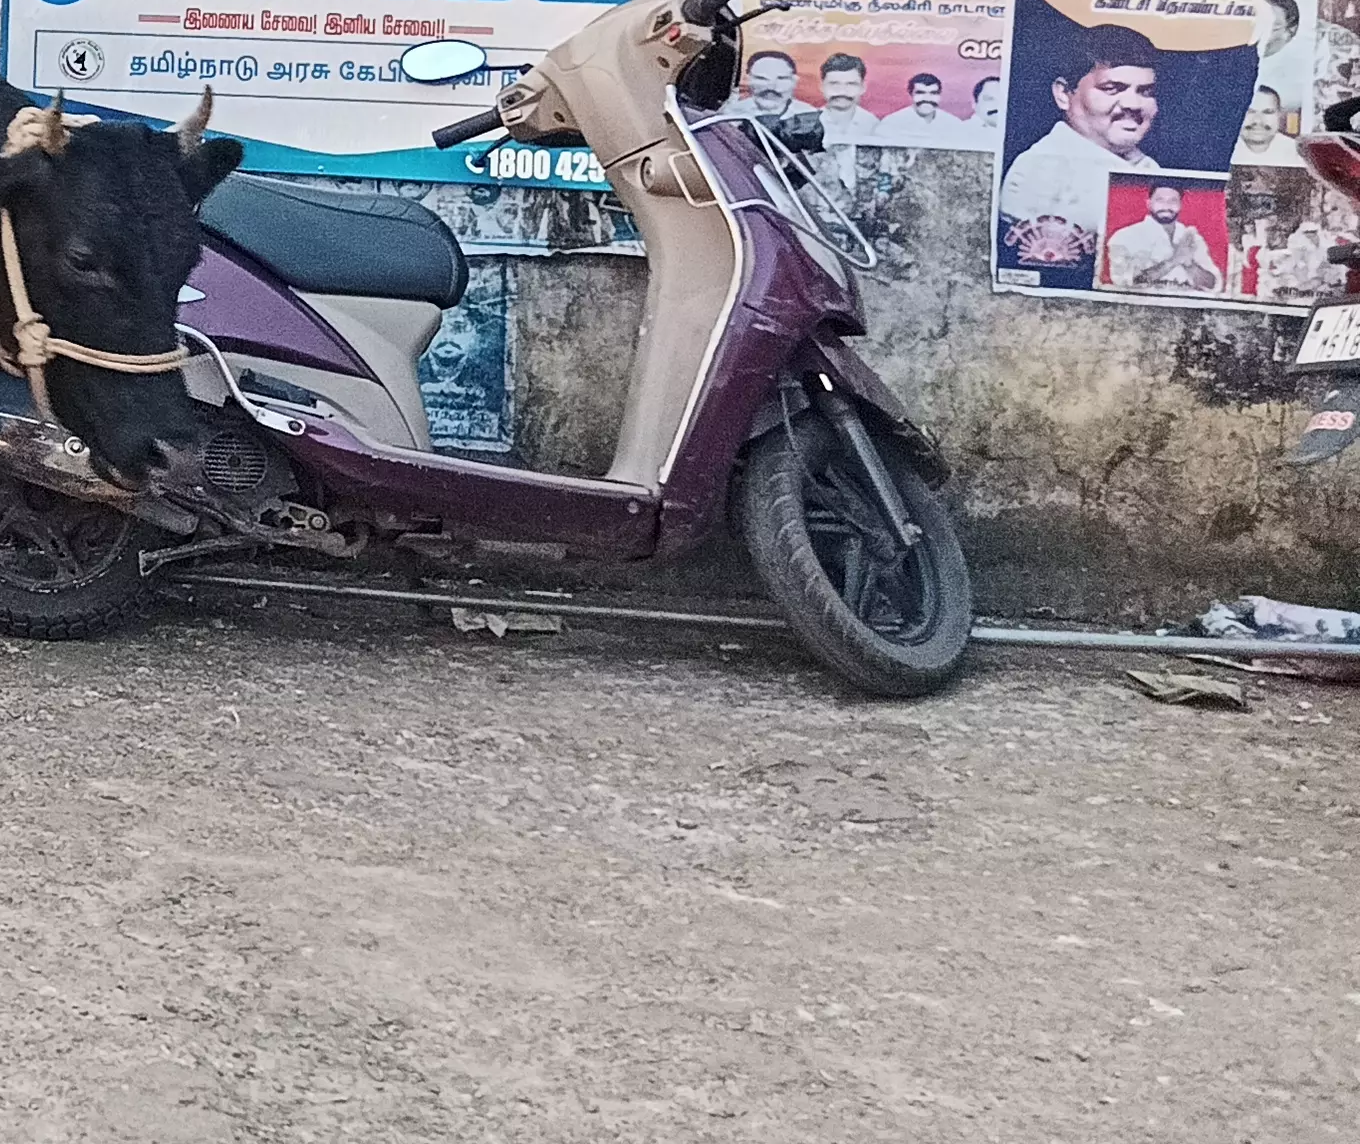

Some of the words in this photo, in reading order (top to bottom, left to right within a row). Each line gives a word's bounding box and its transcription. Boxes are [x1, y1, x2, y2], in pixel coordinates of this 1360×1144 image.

[184, 7, 254, 31] இணைய
[324, 13, 377, 37] இனிய
[129, 50, 259, 83] தமிழ்நாடு
[266, 56, 331, 85] அரசு
[339, 59, 414, 84] கேபி
[487, 147, 551, 181] 1800
